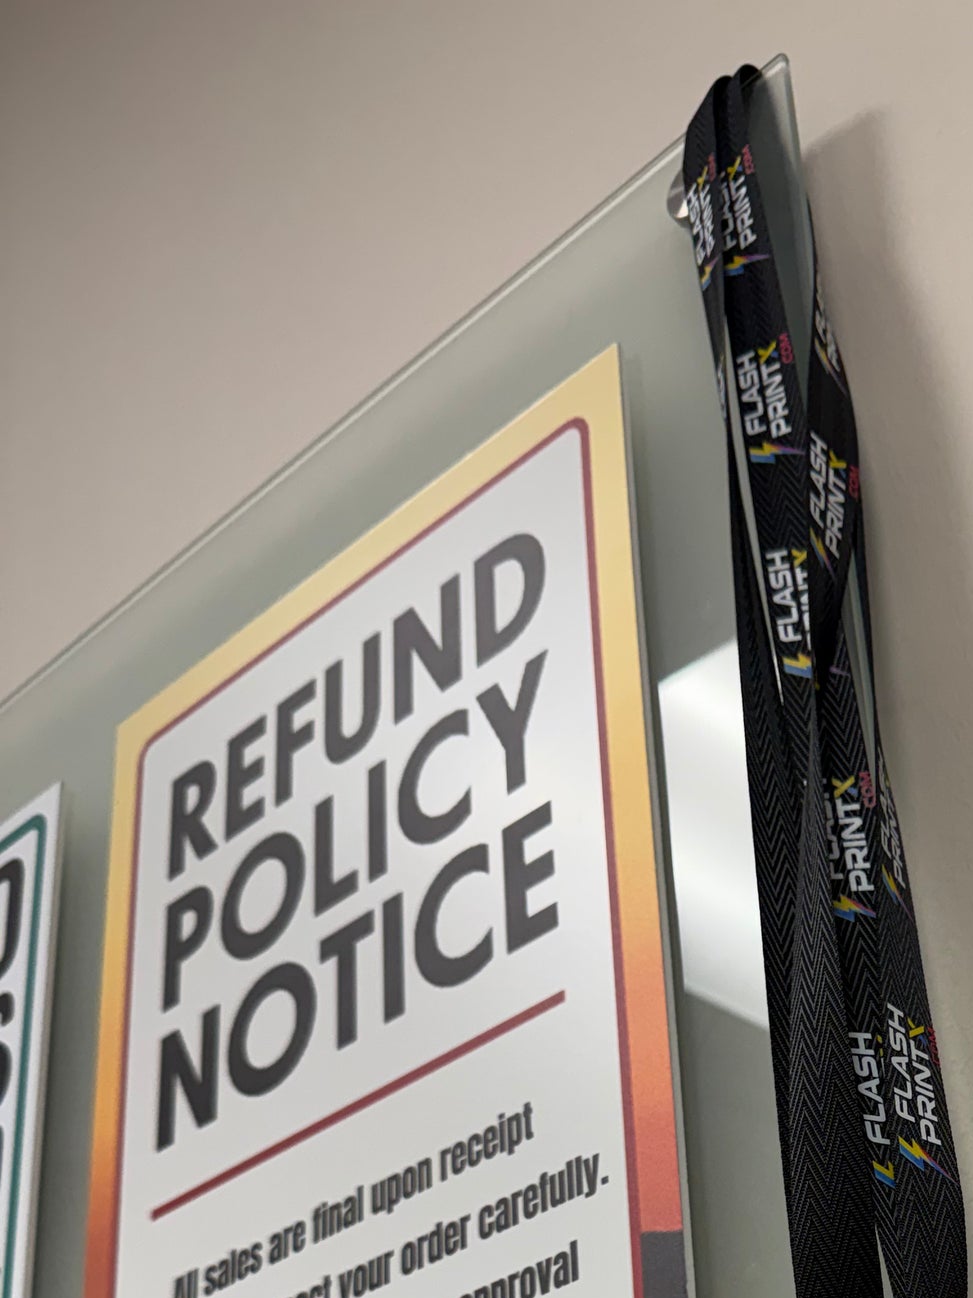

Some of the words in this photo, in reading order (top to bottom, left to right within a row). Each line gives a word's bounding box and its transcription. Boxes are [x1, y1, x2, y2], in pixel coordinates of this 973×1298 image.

[736, 350, 767, 437] FLASH
[757, 340, 792, 439] PRINTX
[810, 430, 828, 530] FLASH
[766, 549, 803, 645] FLASH
[168, 532, 546, 881] REFUND
[161, 649, 549, 1013] POLICY
[832, 776, 875, 892] PRINTX
[155, 800, 559, 1153] NOTICE
[849, 1031, 890, 1145] FLASH
[887, 1003, 916, 1123] FLASH
[907, 1017, 942, 1146] PRINTX
[203, 1242, 263, 1297] sales
[269, 1220, 306, 1265] are
[312, 1185, 364, 1244] final
[371, 1157, 433, 1214] upon
[440, 1101, 534, 1182] receipt
[400, 1214, 471, 1275] order
[478, 1153, 609, 1240] carefully.
